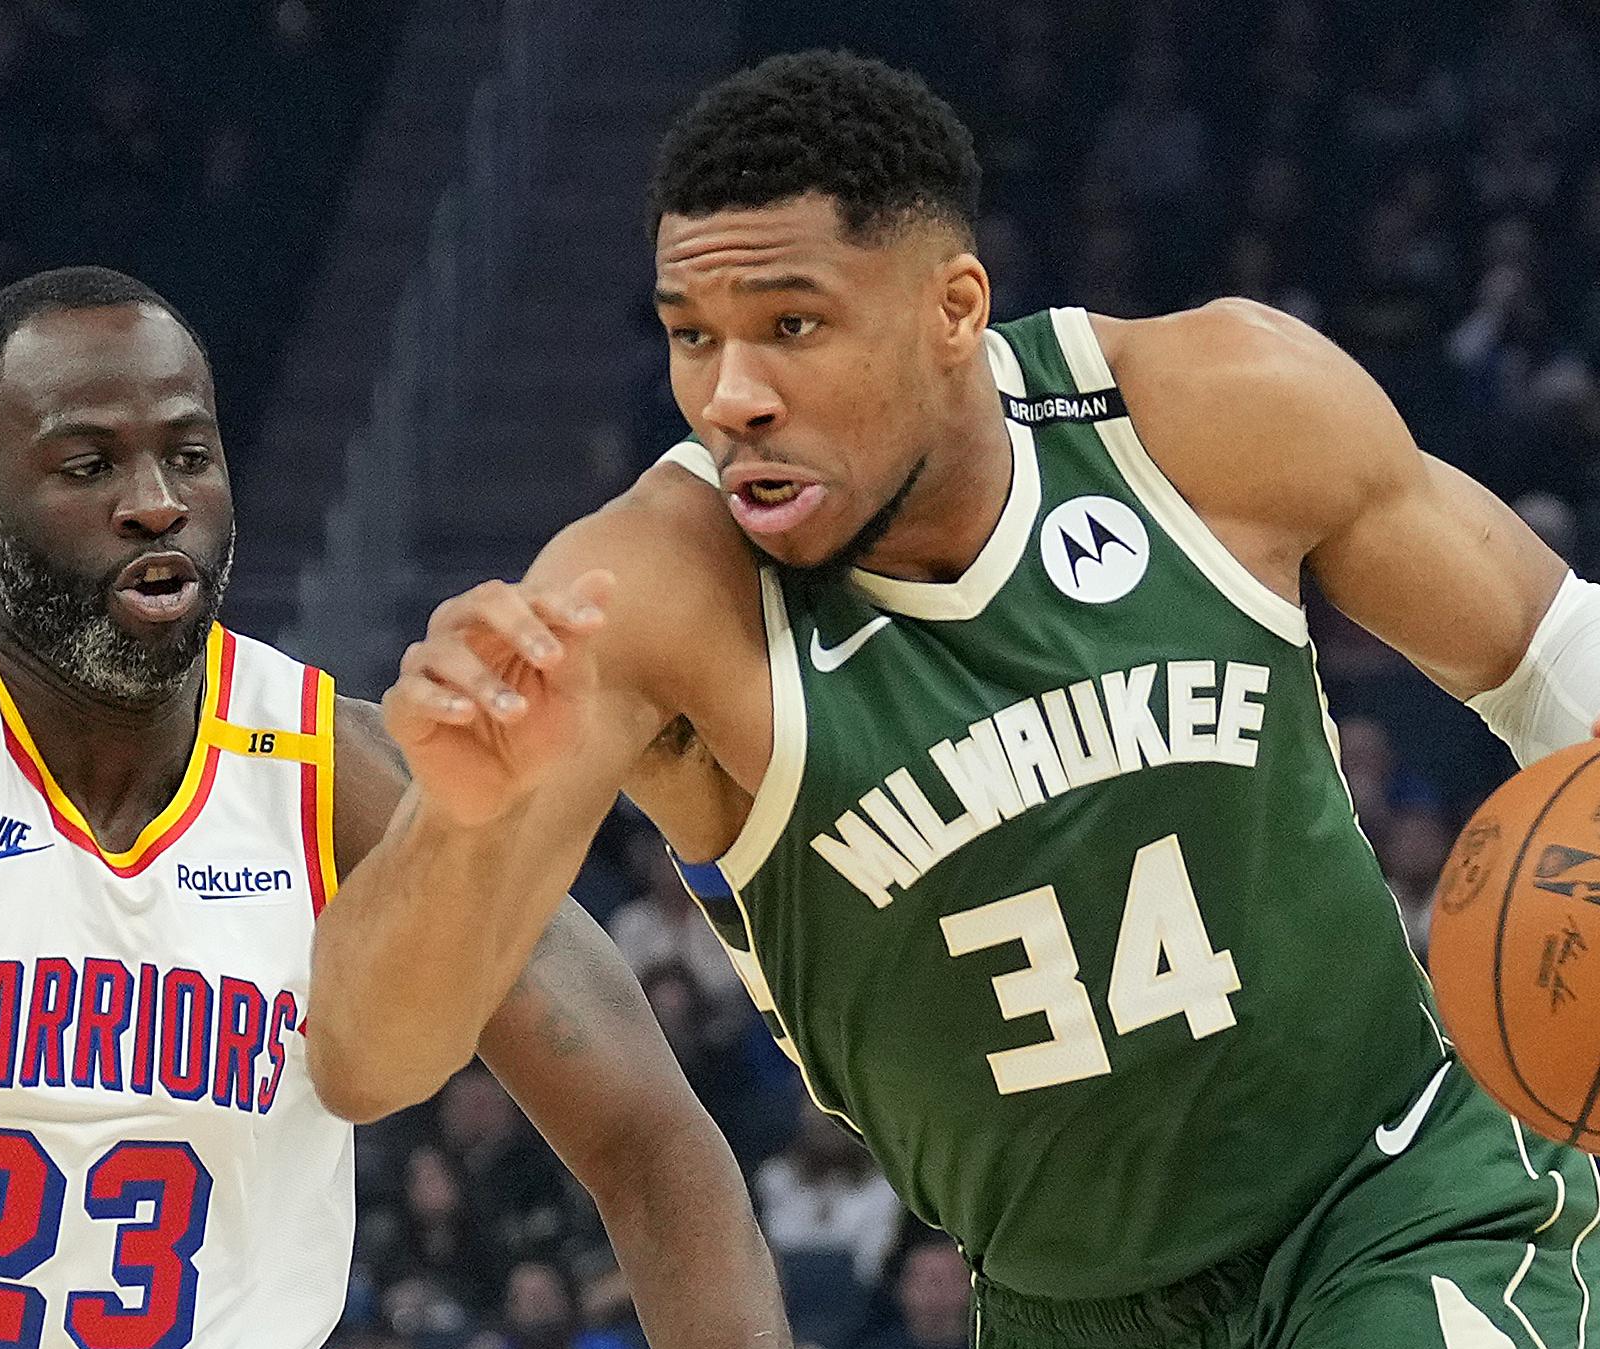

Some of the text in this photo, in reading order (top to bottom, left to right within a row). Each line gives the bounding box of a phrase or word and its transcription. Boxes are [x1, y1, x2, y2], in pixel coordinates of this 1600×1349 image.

[1008, 395, 1109, 422] BRIDGEMAN
[247, 733, 276, 753] 16
[809, 659, 1272, 909] MILWAUKEE
[176, 862, 292, 893] Rakuten
[938, 832, 1242, 1096] 34
